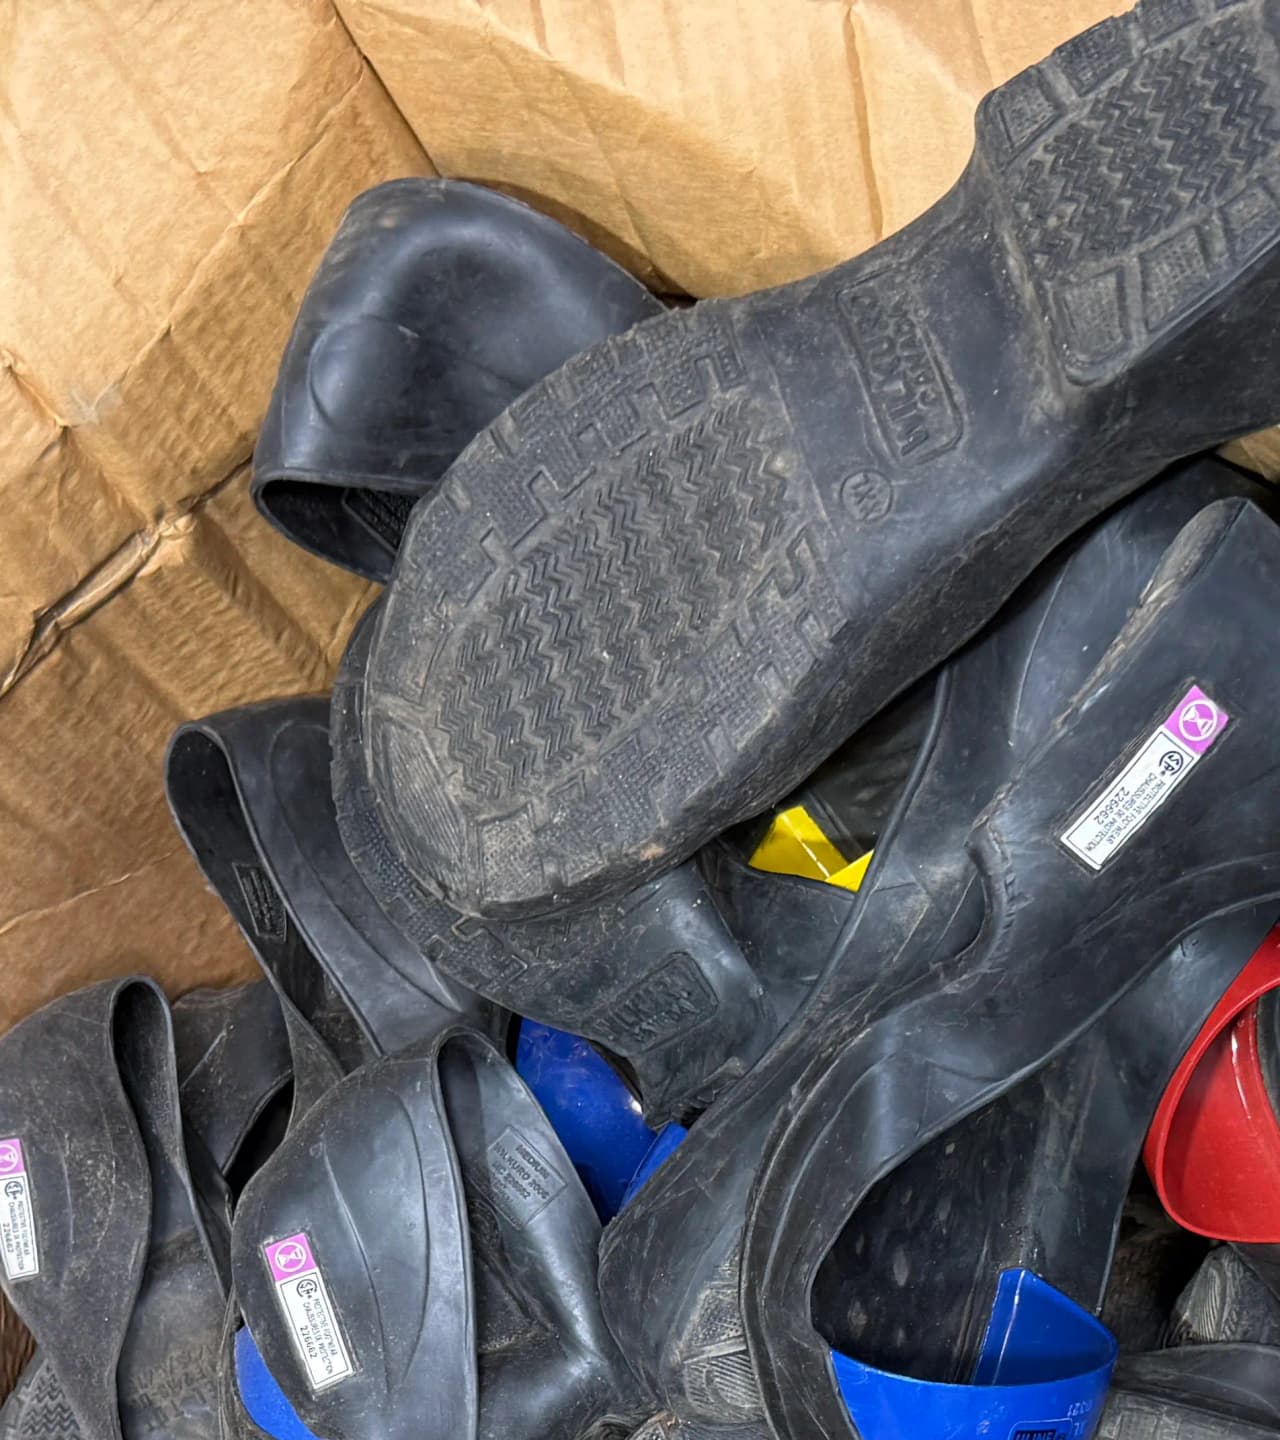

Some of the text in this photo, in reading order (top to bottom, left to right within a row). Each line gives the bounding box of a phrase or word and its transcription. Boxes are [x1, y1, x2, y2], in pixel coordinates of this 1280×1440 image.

[842, 287, 934, 457] WILKURO
[884, 298, 944, 409] CANADA
[1093, 786, 1130, 824] 226662
[1131, 779, 1166, 815] PROTECTIVE
[1083, 814, 1119, 852] PROTECTION
[493, 1142, 530, 1181] WILKURO
[515, 1143, 549, 1179] MEDIUM
